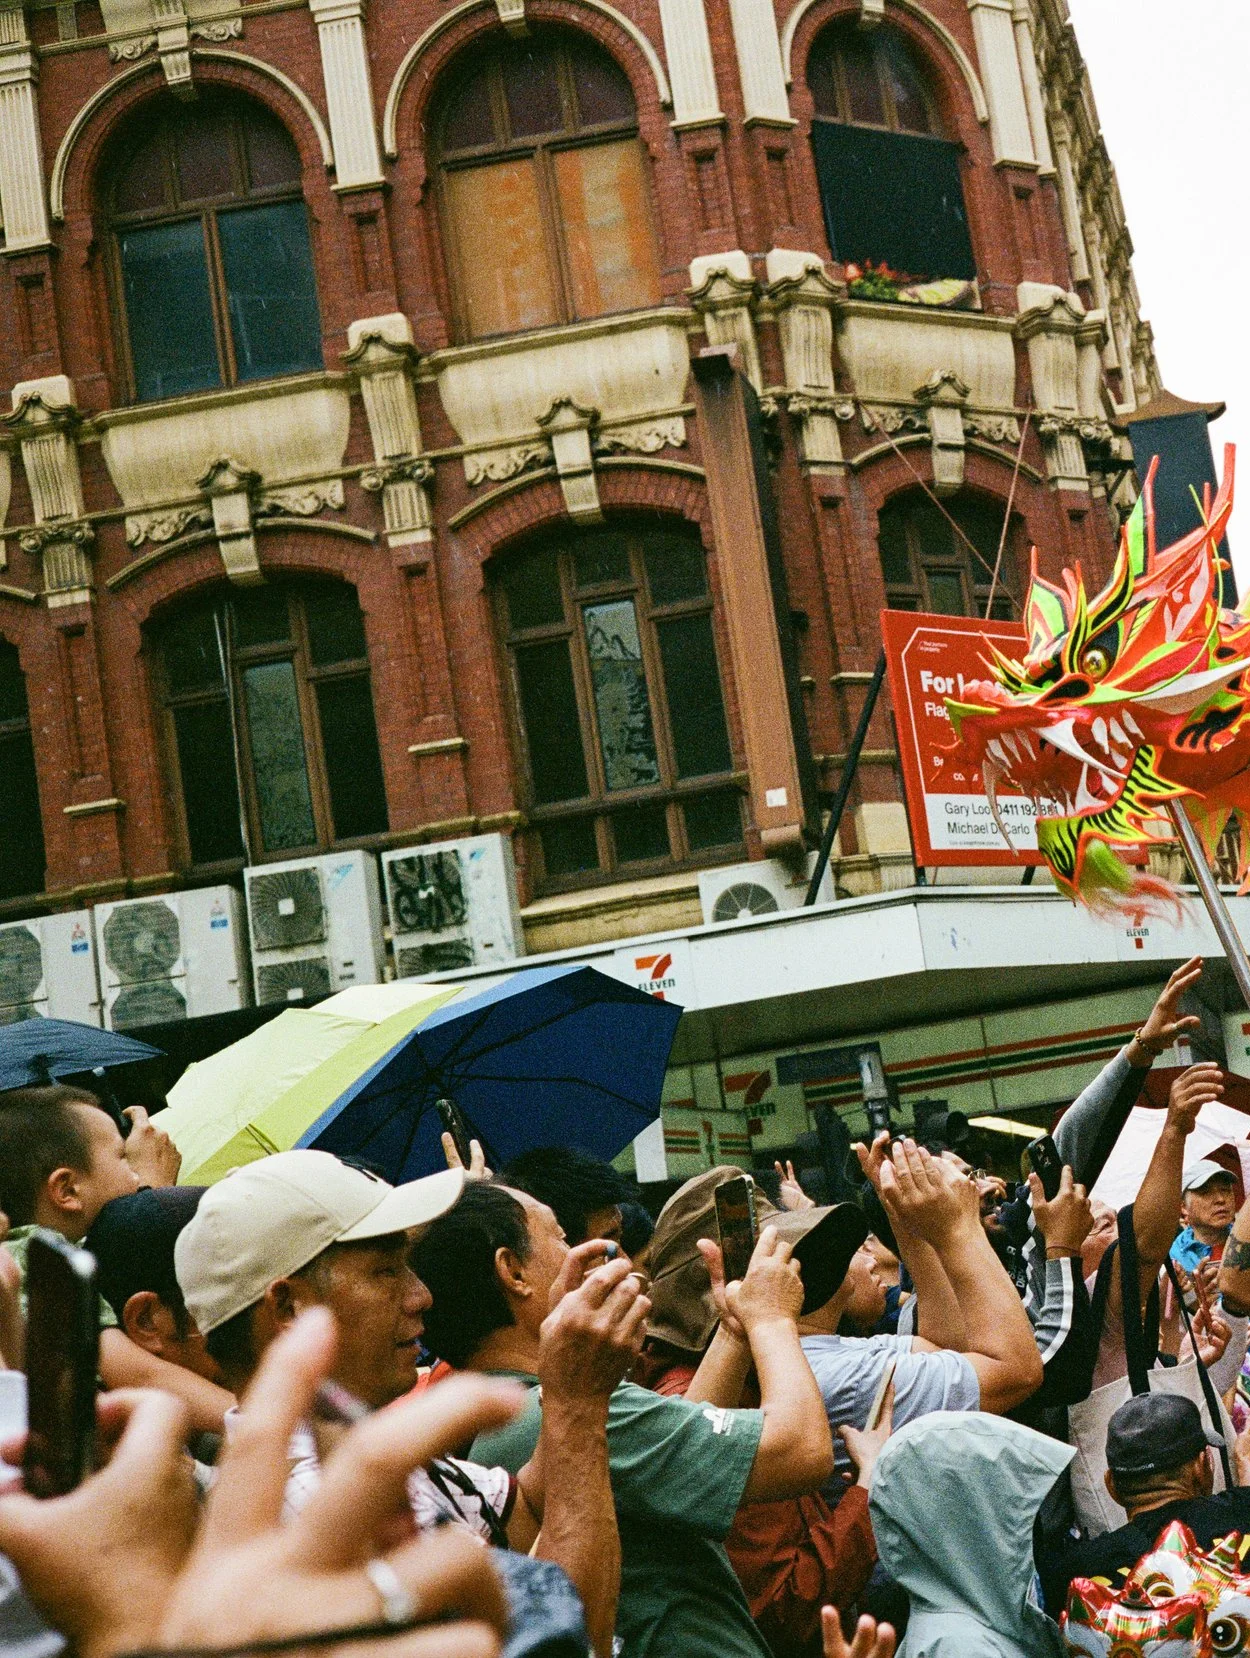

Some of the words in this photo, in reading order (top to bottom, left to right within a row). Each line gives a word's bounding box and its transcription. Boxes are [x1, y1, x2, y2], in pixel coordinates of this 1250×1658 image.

[920, 670, 954, 694] For
[944, 802, 969, 817] Gary
[947, 822, 988, 835] Michael
[634, 953, 672, 1001] 7
[723, 1069, 772, 1135] 7
